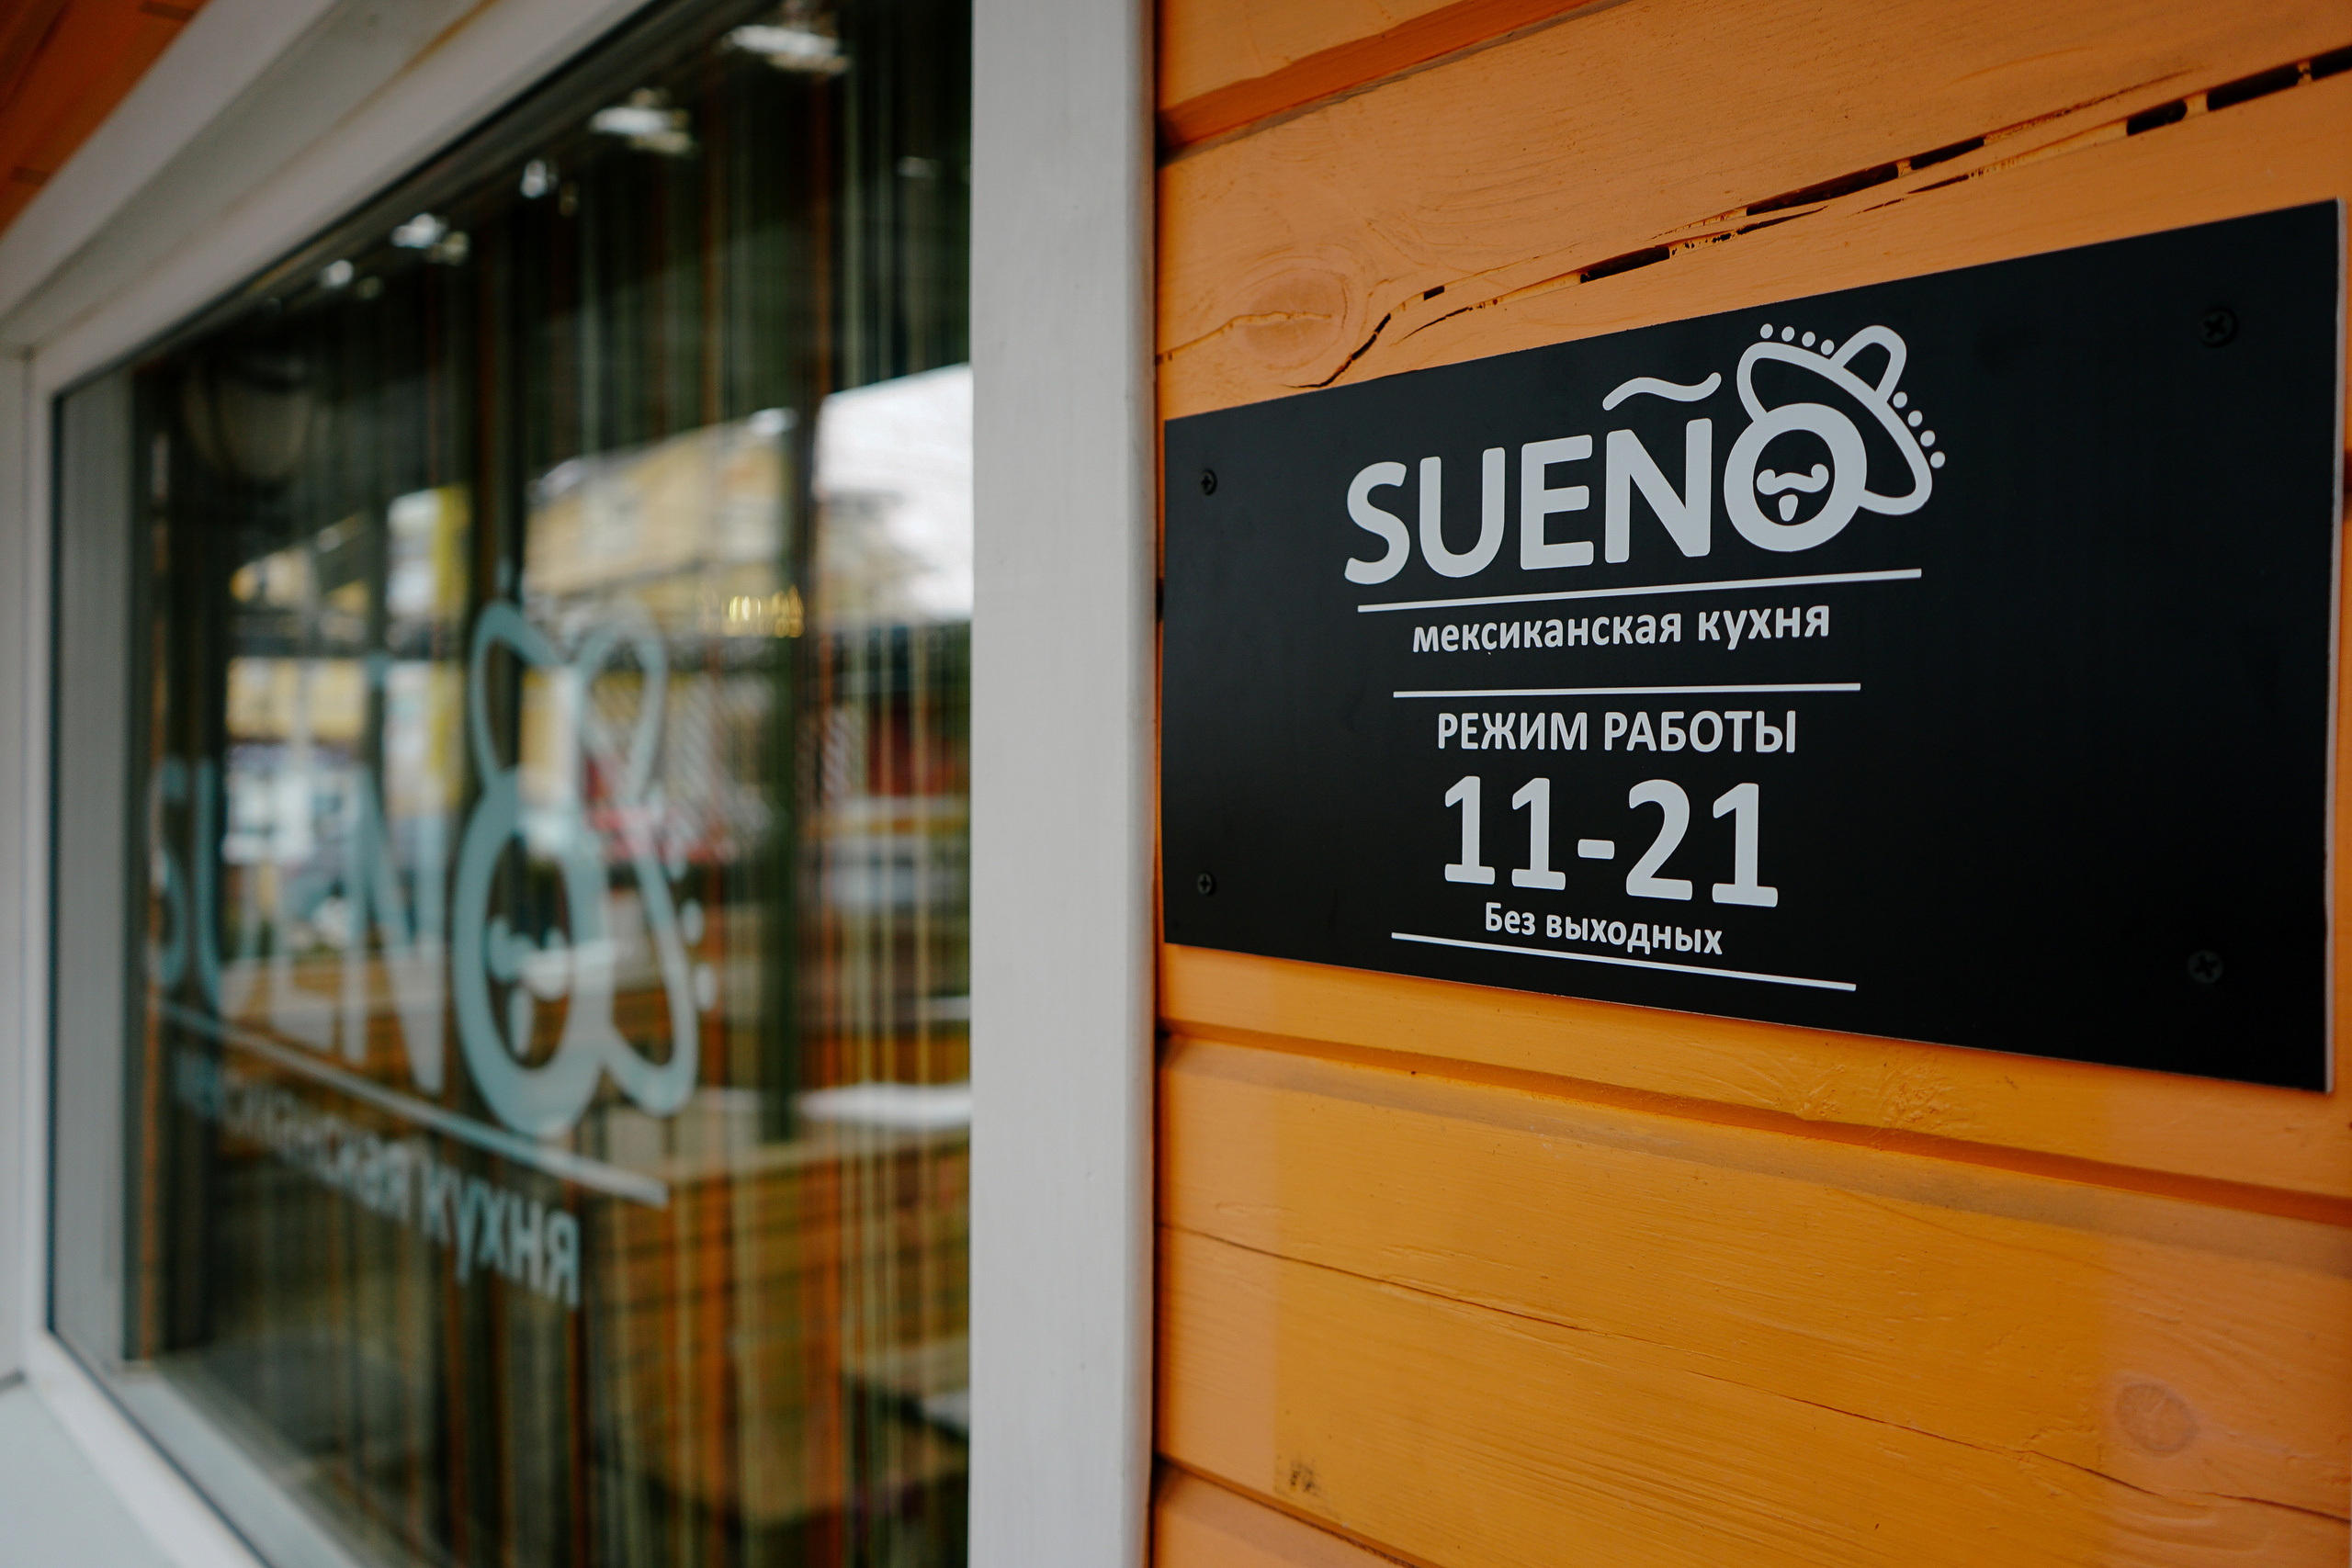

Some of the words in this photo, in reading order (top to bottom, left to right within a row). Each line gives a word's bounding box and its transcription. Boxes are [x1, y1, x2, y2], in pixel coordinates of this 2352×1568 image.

[1345, 373, 1867, 584] SUEÑO
[1413, 613, 1680, 653] мексиканская
[1698, 605, 1829, 650] кухня
[1438, 712, 1588, 750] РЕЖИМ
[1604, 710, 1796, 753] РАБОТЫ
[1444, 775, 1779, 908] 11-21
[1485, 902, 1536, 936] Без
[1546, 914, 1723, 955] выходных
